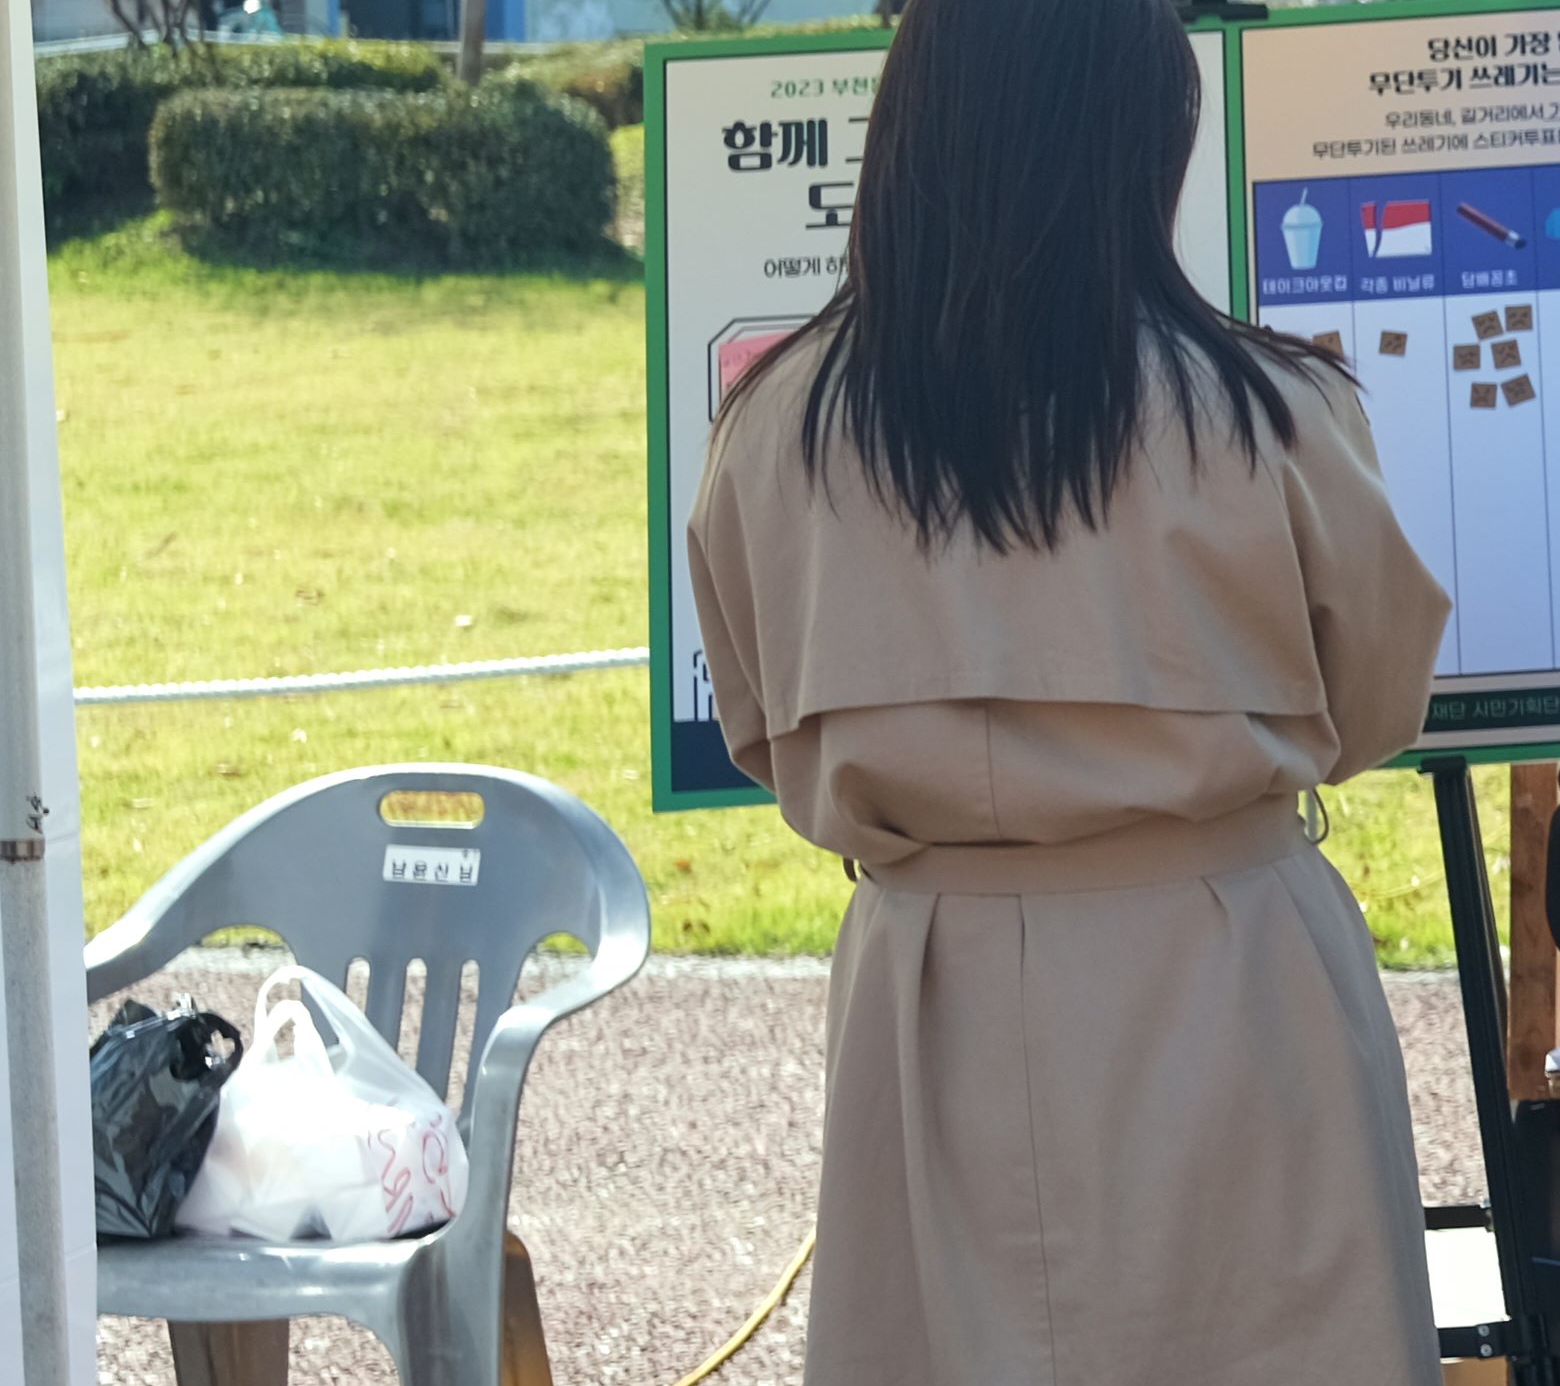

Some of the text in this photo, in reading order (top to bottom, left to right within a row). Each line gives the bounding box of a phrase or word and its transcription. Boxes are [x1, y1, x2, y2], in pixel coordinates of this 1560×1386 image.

[1427, 34, 1498, 62] 당신이
[1504, 32, 1551, 58] 가장
[770, 78, 824, 99] 2023
[1368, 67, 1462, 97] 무단투기
[1460, 102, 1544, 125] 길거리에서
[721, 117, 829, 173] 함께
[1312, 137, 1397, 160] 무단투기된
[1401, 133, 1469, 155] 쓰레기에
